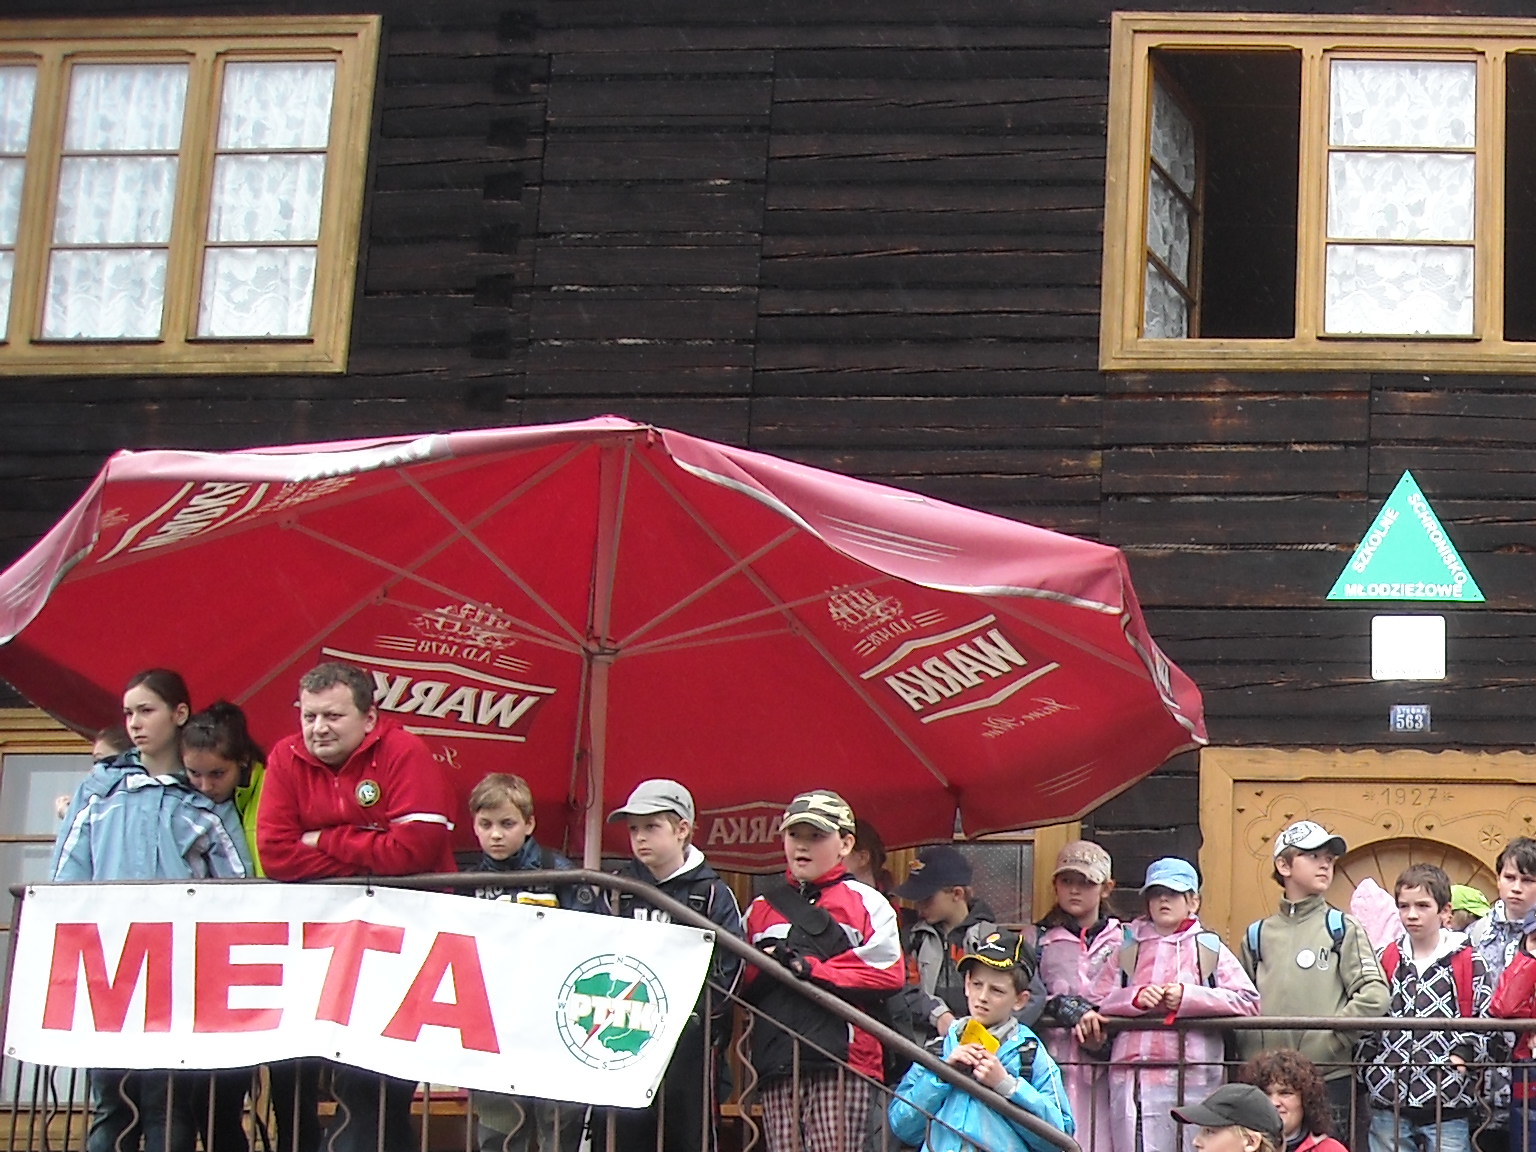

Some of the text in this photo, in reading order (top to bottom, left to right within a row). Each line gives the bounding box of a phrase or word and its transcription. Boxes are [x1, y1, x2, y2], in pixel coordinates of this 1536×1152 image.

[1352, 507, 1400, 573] SZKOLNE
[1407, 493, 1468, 585] SCHRONISKO
[1344, 581, 1463, 597] MŁODZIEŻOWE
[1396, 713, 1424, 729] 563
[1381, 787, 1438, 806] 1927
[42, 919, 500, 1054] META
